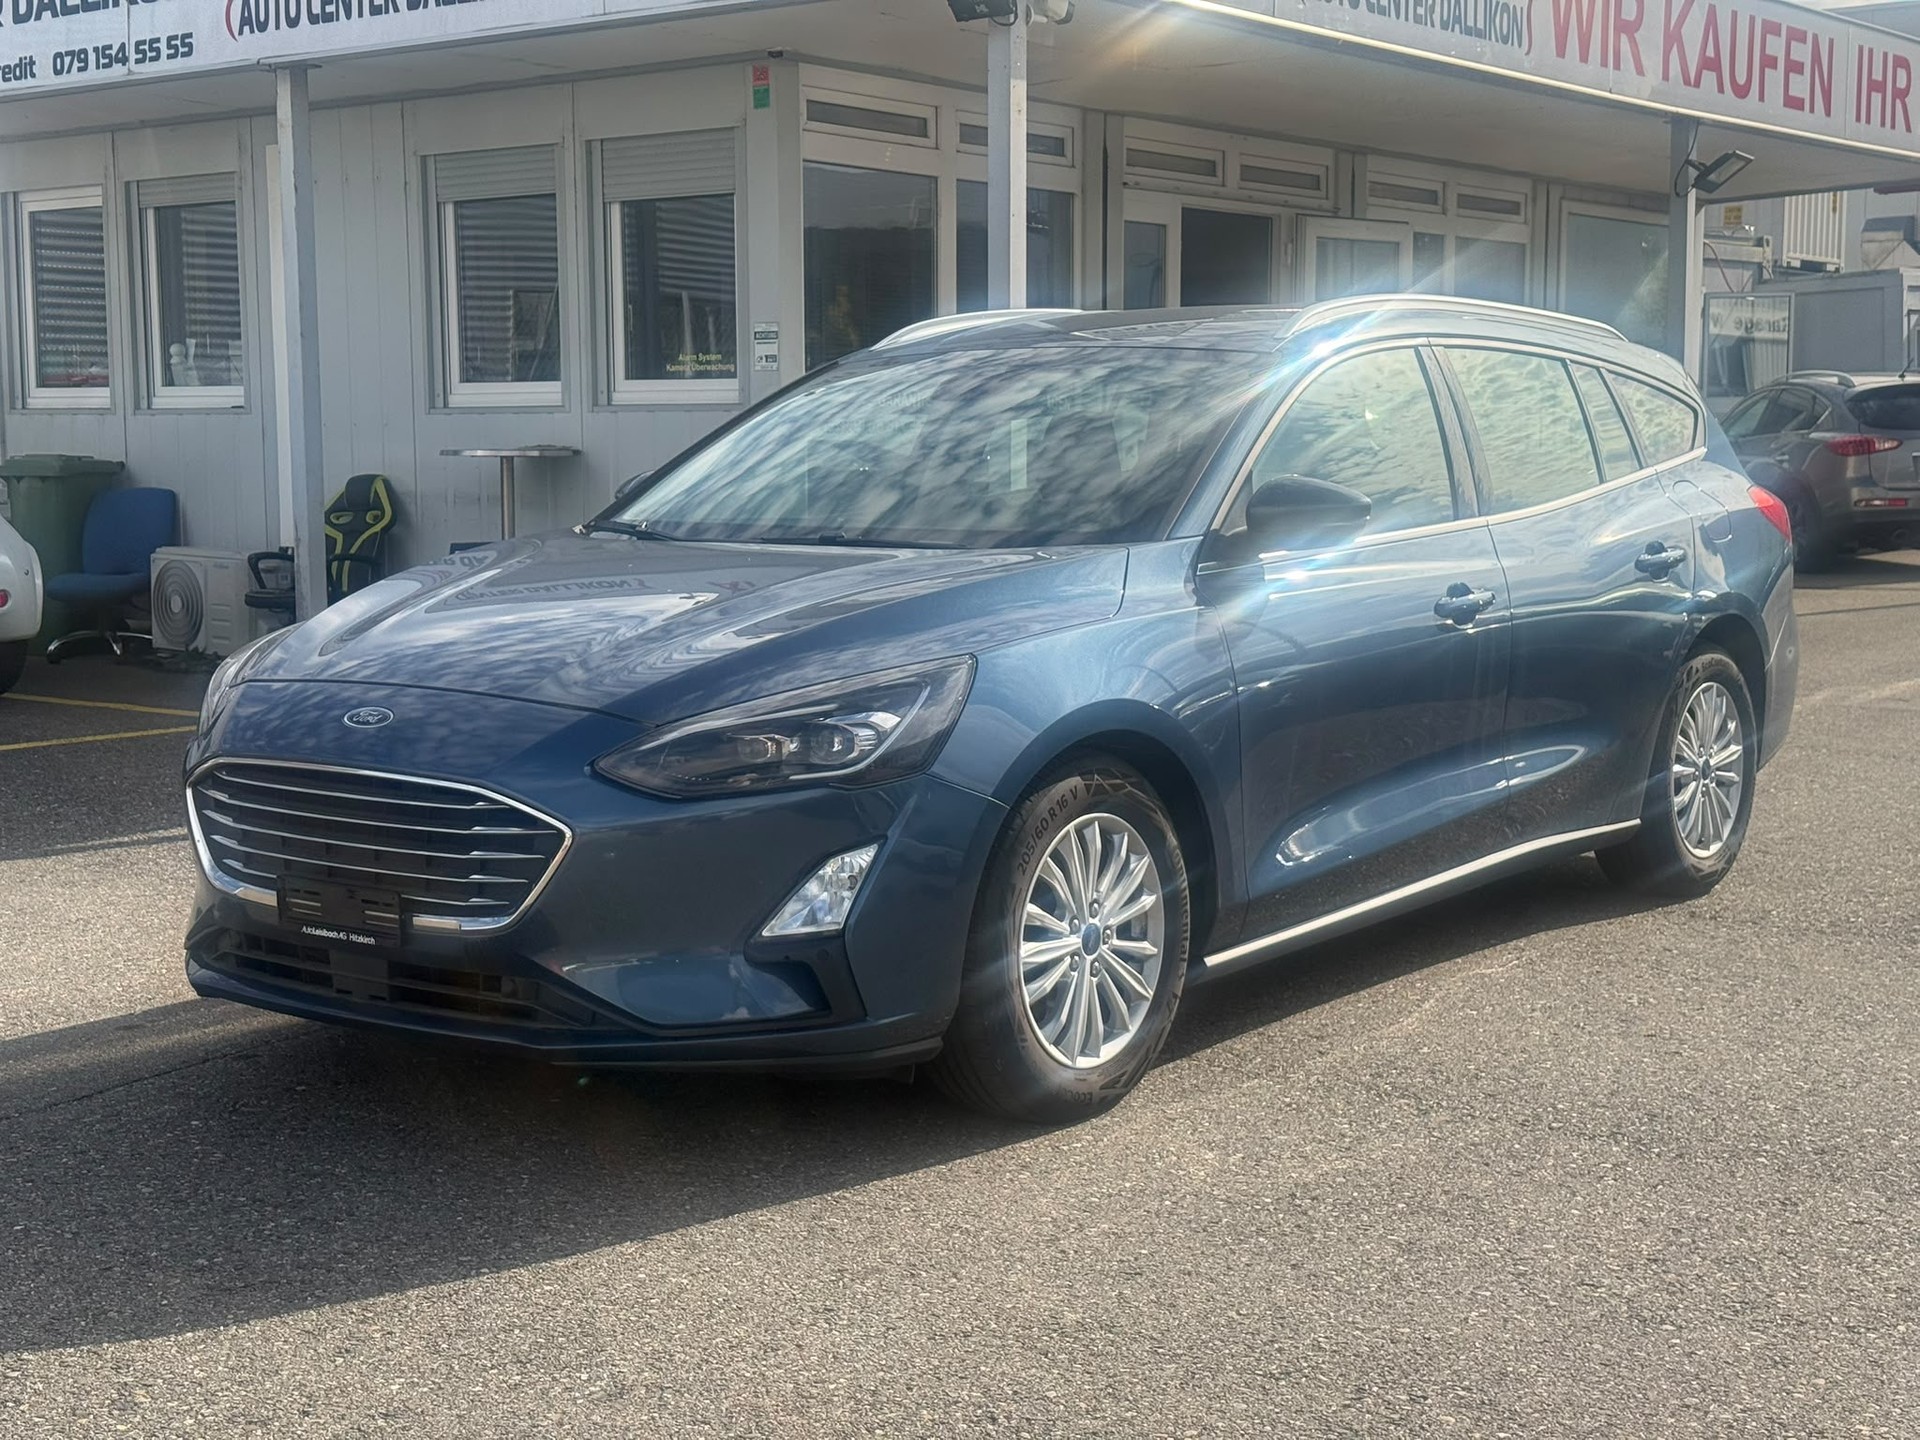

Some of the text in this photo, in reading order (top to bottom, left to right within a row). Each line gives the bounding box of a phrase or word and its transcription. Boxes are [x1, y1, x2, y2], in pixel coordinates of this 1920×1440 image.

[238, 0, 300, 35] AUTO
[0, 32, 193, 83] edit 079 154 55 55
[1552, 0, 1912, 133] WIR KAUFEN IHR
[698, 352, 722, 362] System
[1017, 785, 1078, 876] 205/60 R 16 V
